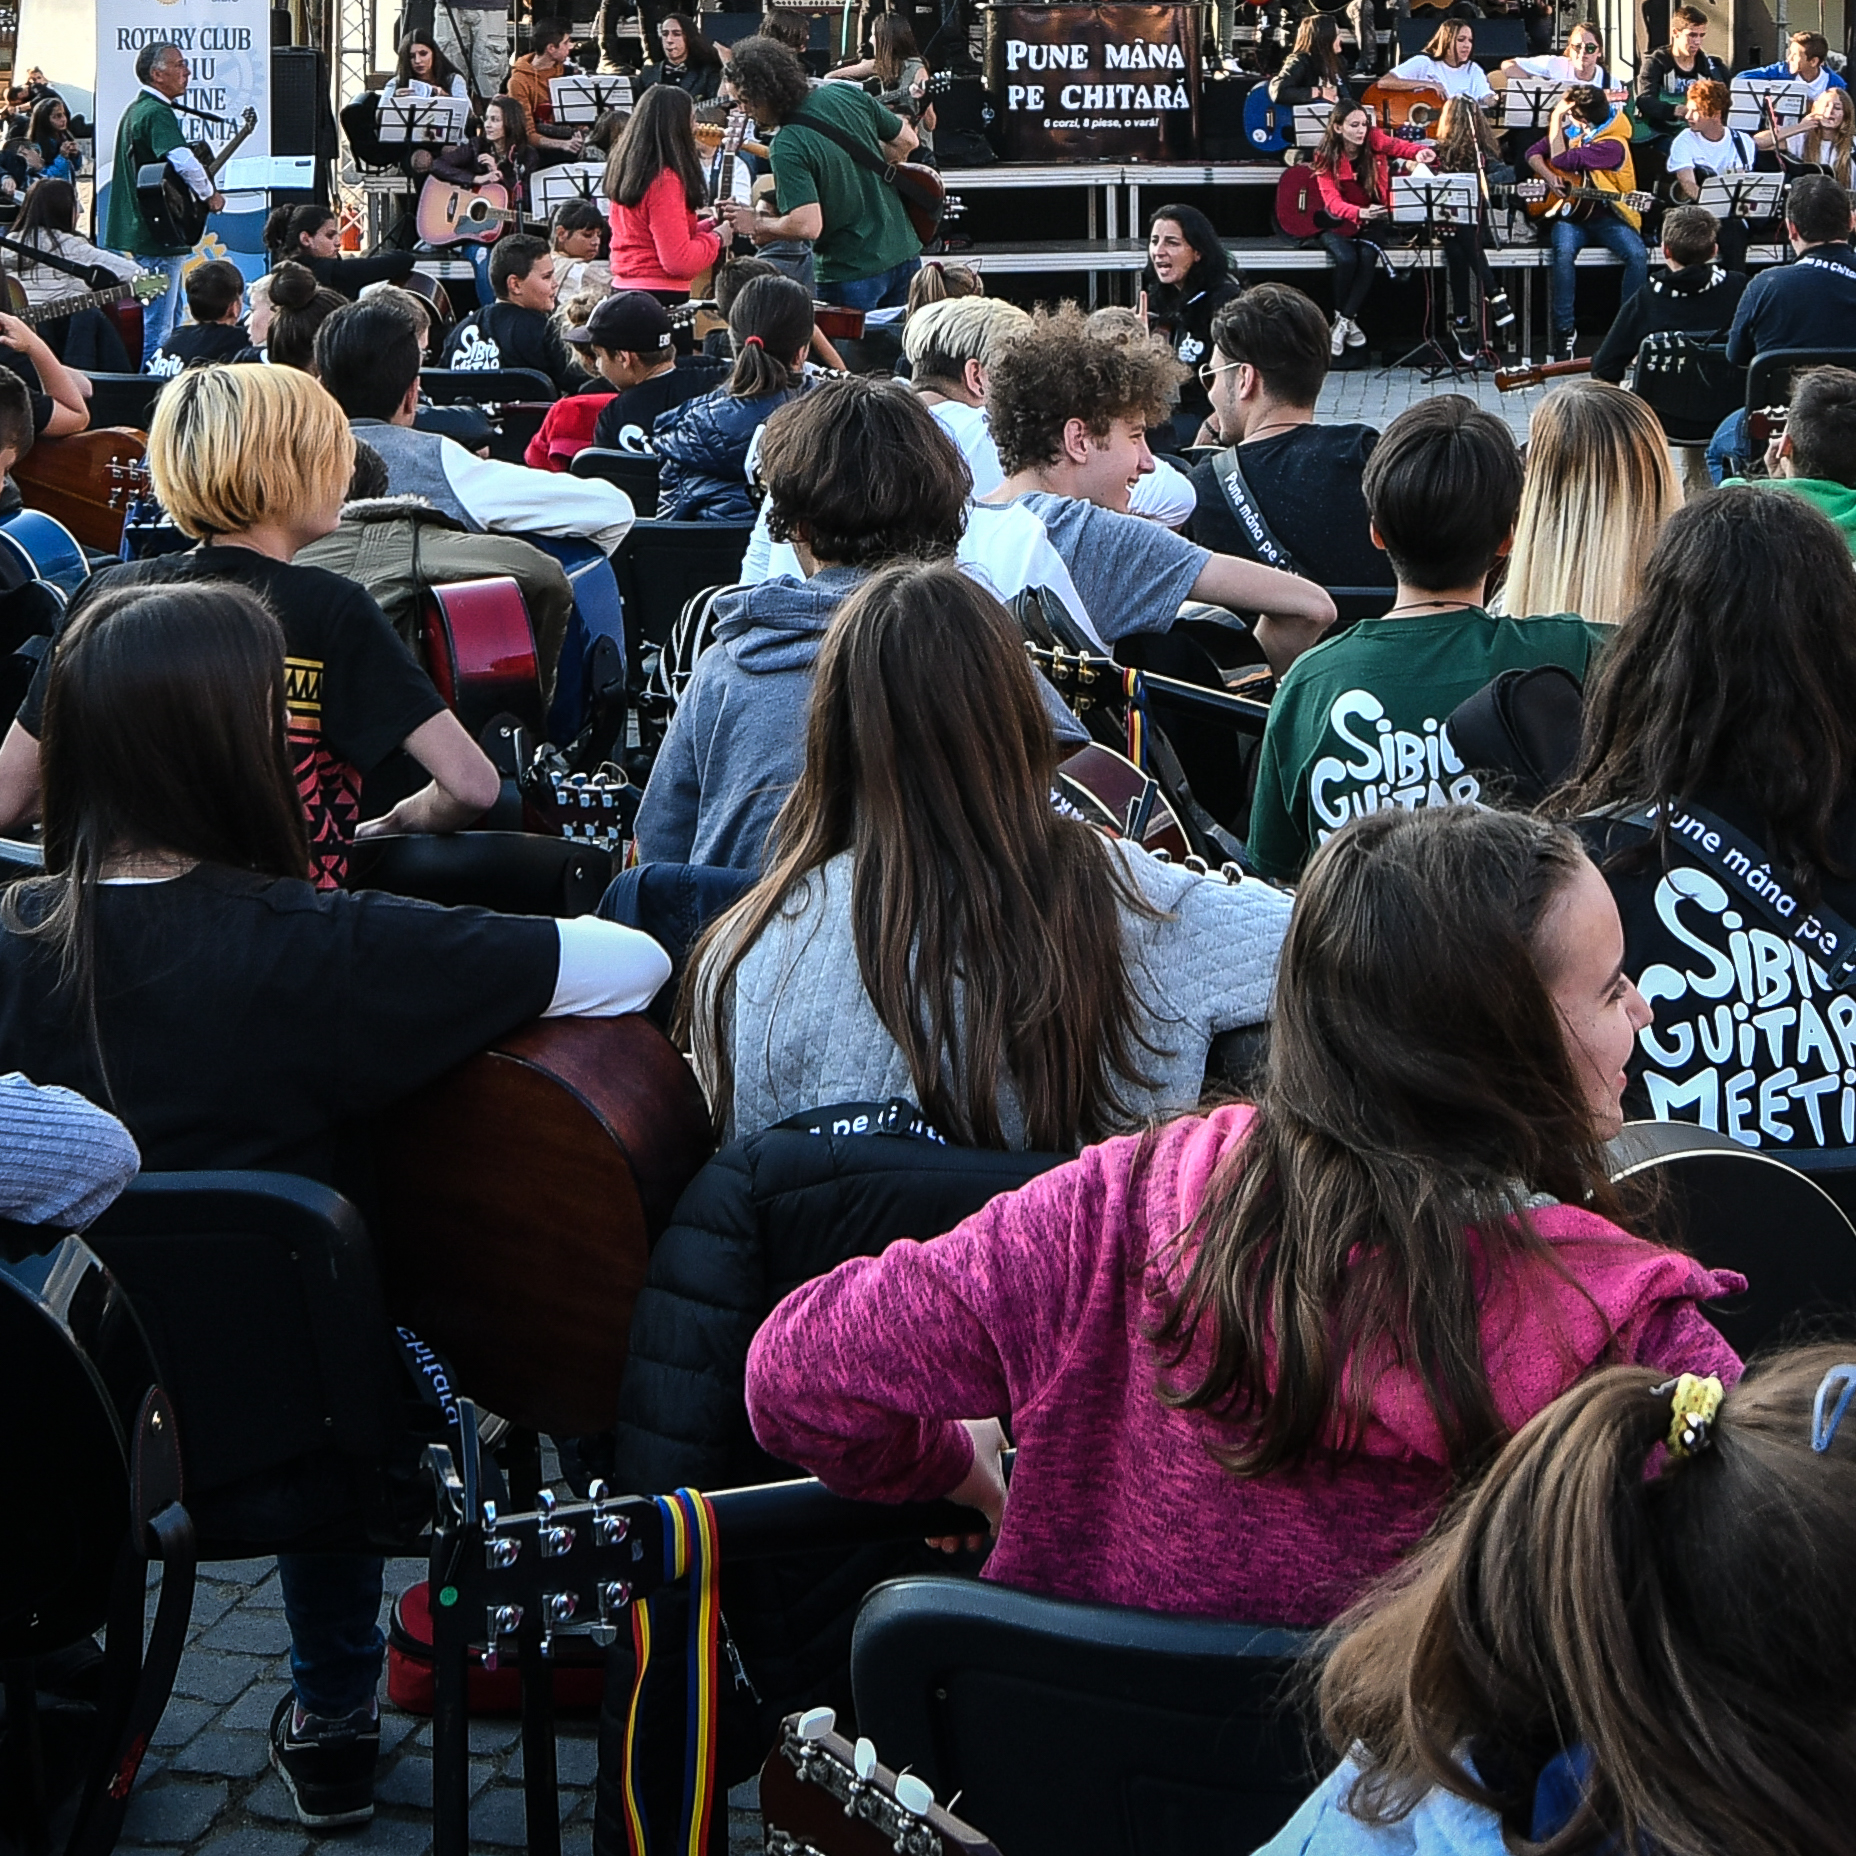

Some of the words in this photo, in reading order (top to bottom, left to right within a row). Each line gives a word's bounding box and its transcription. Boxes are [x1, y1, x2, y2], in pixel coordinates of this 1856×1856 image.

[116, 27, 196, 51] ROTARY
[199, 27, 252, 51] CLUB
[1005, 39, 1089, 71] PUNE
[1008, 84, 1045, 111] PE
[1060, 77, 1191, 110] CHITARĂ
[1043, 118, 1051, 128] 6
[1052, 117, 1080, 129] corzi,
[1082, 118, 1090, 128] 8
[1090, 117, 1122, 130] piese,
[1224, 470, 1245, 507] Pune
[1239, 504, 1264, 542] mâna
[1257, 540, 1278, 563] pe
[1722, 846, 1798, 919] mâna
